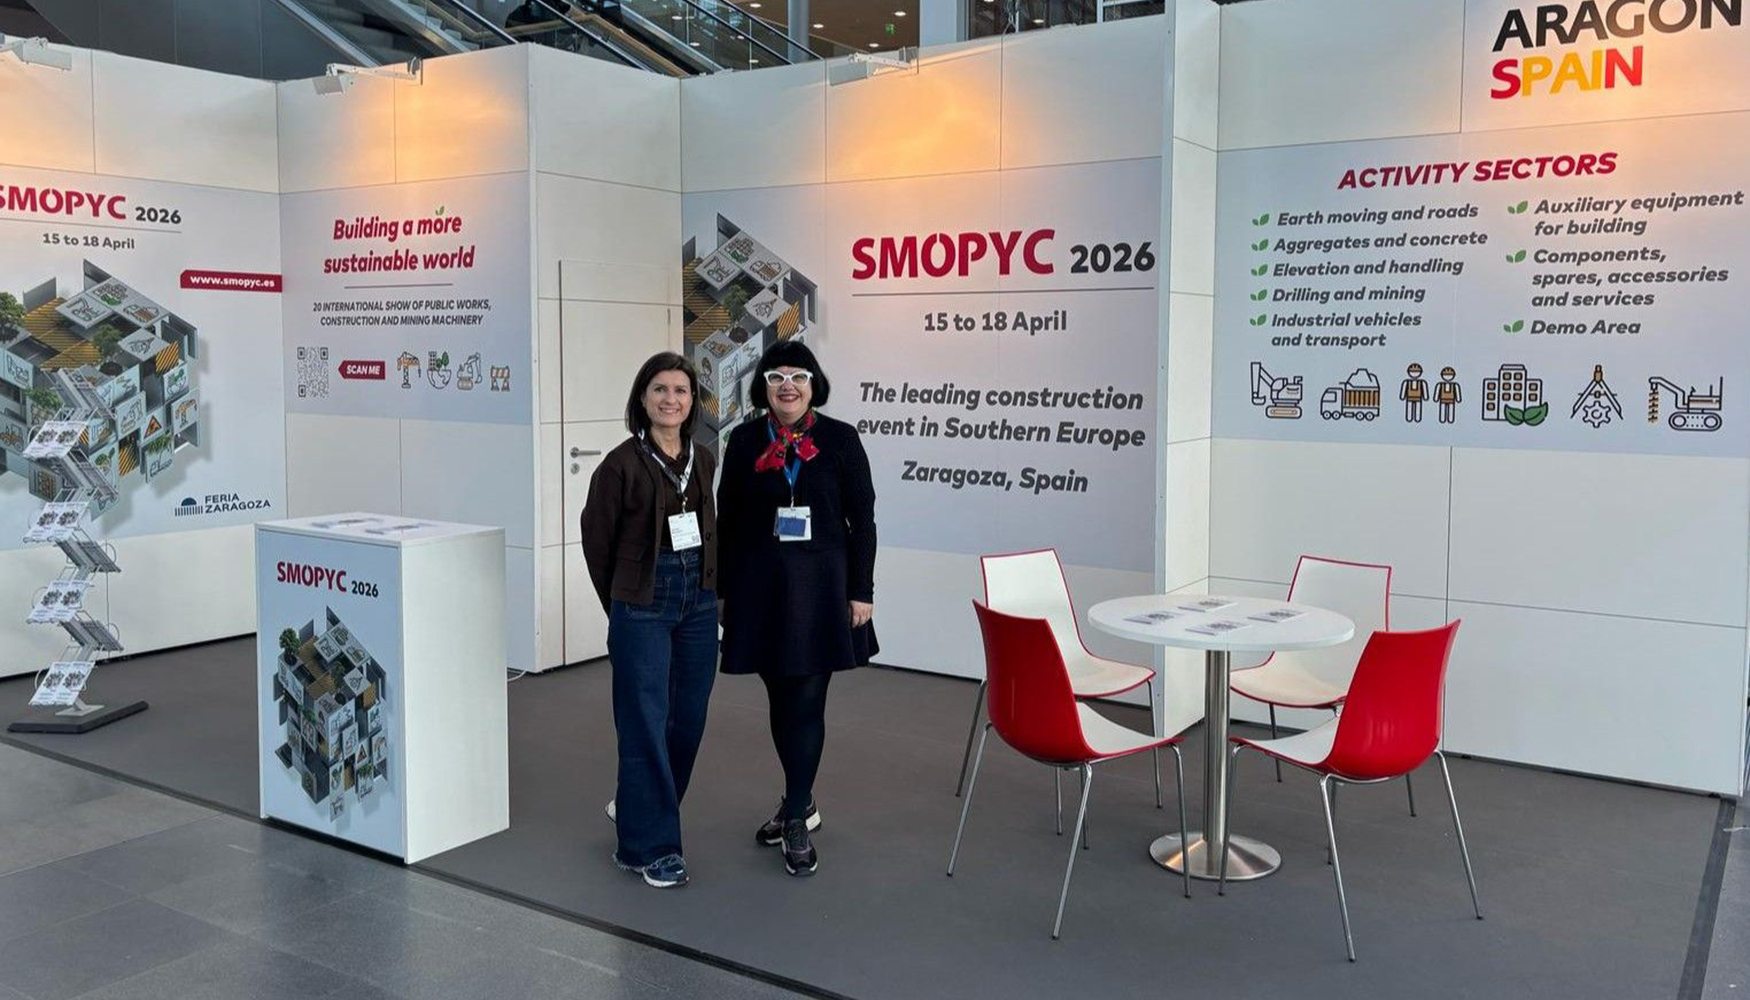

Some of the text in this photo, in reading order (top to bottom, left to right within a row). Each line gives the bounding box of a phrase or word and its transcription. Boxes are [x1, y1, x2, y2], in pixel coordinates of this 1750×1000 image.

[1491, 46, 1643, 100] SPAIN
[1337, 153, 1618, 190] ACTIVITY SECTORS
[0, 186, 181, 225] MOPYC 2026
[1534, 191, 1744, 214] Auxiliary equipment
[1277, 204, 1479, 226] Earth moving and roads
[333, 216, 462, 242] Building a more
[1534, 218, 1647, 236] for building
[43, 233, 135, 250] 15 to 18 April
[1274, 231, 1488, 254] Aggregates and concrete
[324, 245, 475, 274] sustainable world
[852, 229, 1155, 280] SMOPYC 2026
[1534, 247, 1666, 266] Components,
[1273, 258, 1464, 277] Elevation and handling
[1532, 266, 1728, 288] spares, accessories
[190, 275, 275, 288] www.smopyc.es
[313, 299, 491, 311] 20 INTERNATIONAL SHOW OF PUBLIC WORKS,
[1272, 286, 1425, 304] Drilling and mining
[1531, 291, 1655, 307] and services
[320, 315, 483, 326] CONSTRUCTION AND MINING MACHINERY
[924, 310, 1066, 335] 15 to 18 April
[1271, 312, 1422, 327] Industrial vehicles
[1530, 320, 1641, 334] Demo Area
[1271, 333, 1386, 349] and transport
[346, 365, 380, 375] SCAN ME
[859, 382, 1143, 410] The leading construction
[857, 416, 1146, 451] event in Southern Europe
[901, 460, 1088, 494] Zaragoza, Spain
[205, 493, 239, 504] FERIA
[205, 499, 271, 514] ZARAGOZA
[277, 561, 378, 598] SMOPYC 2026
